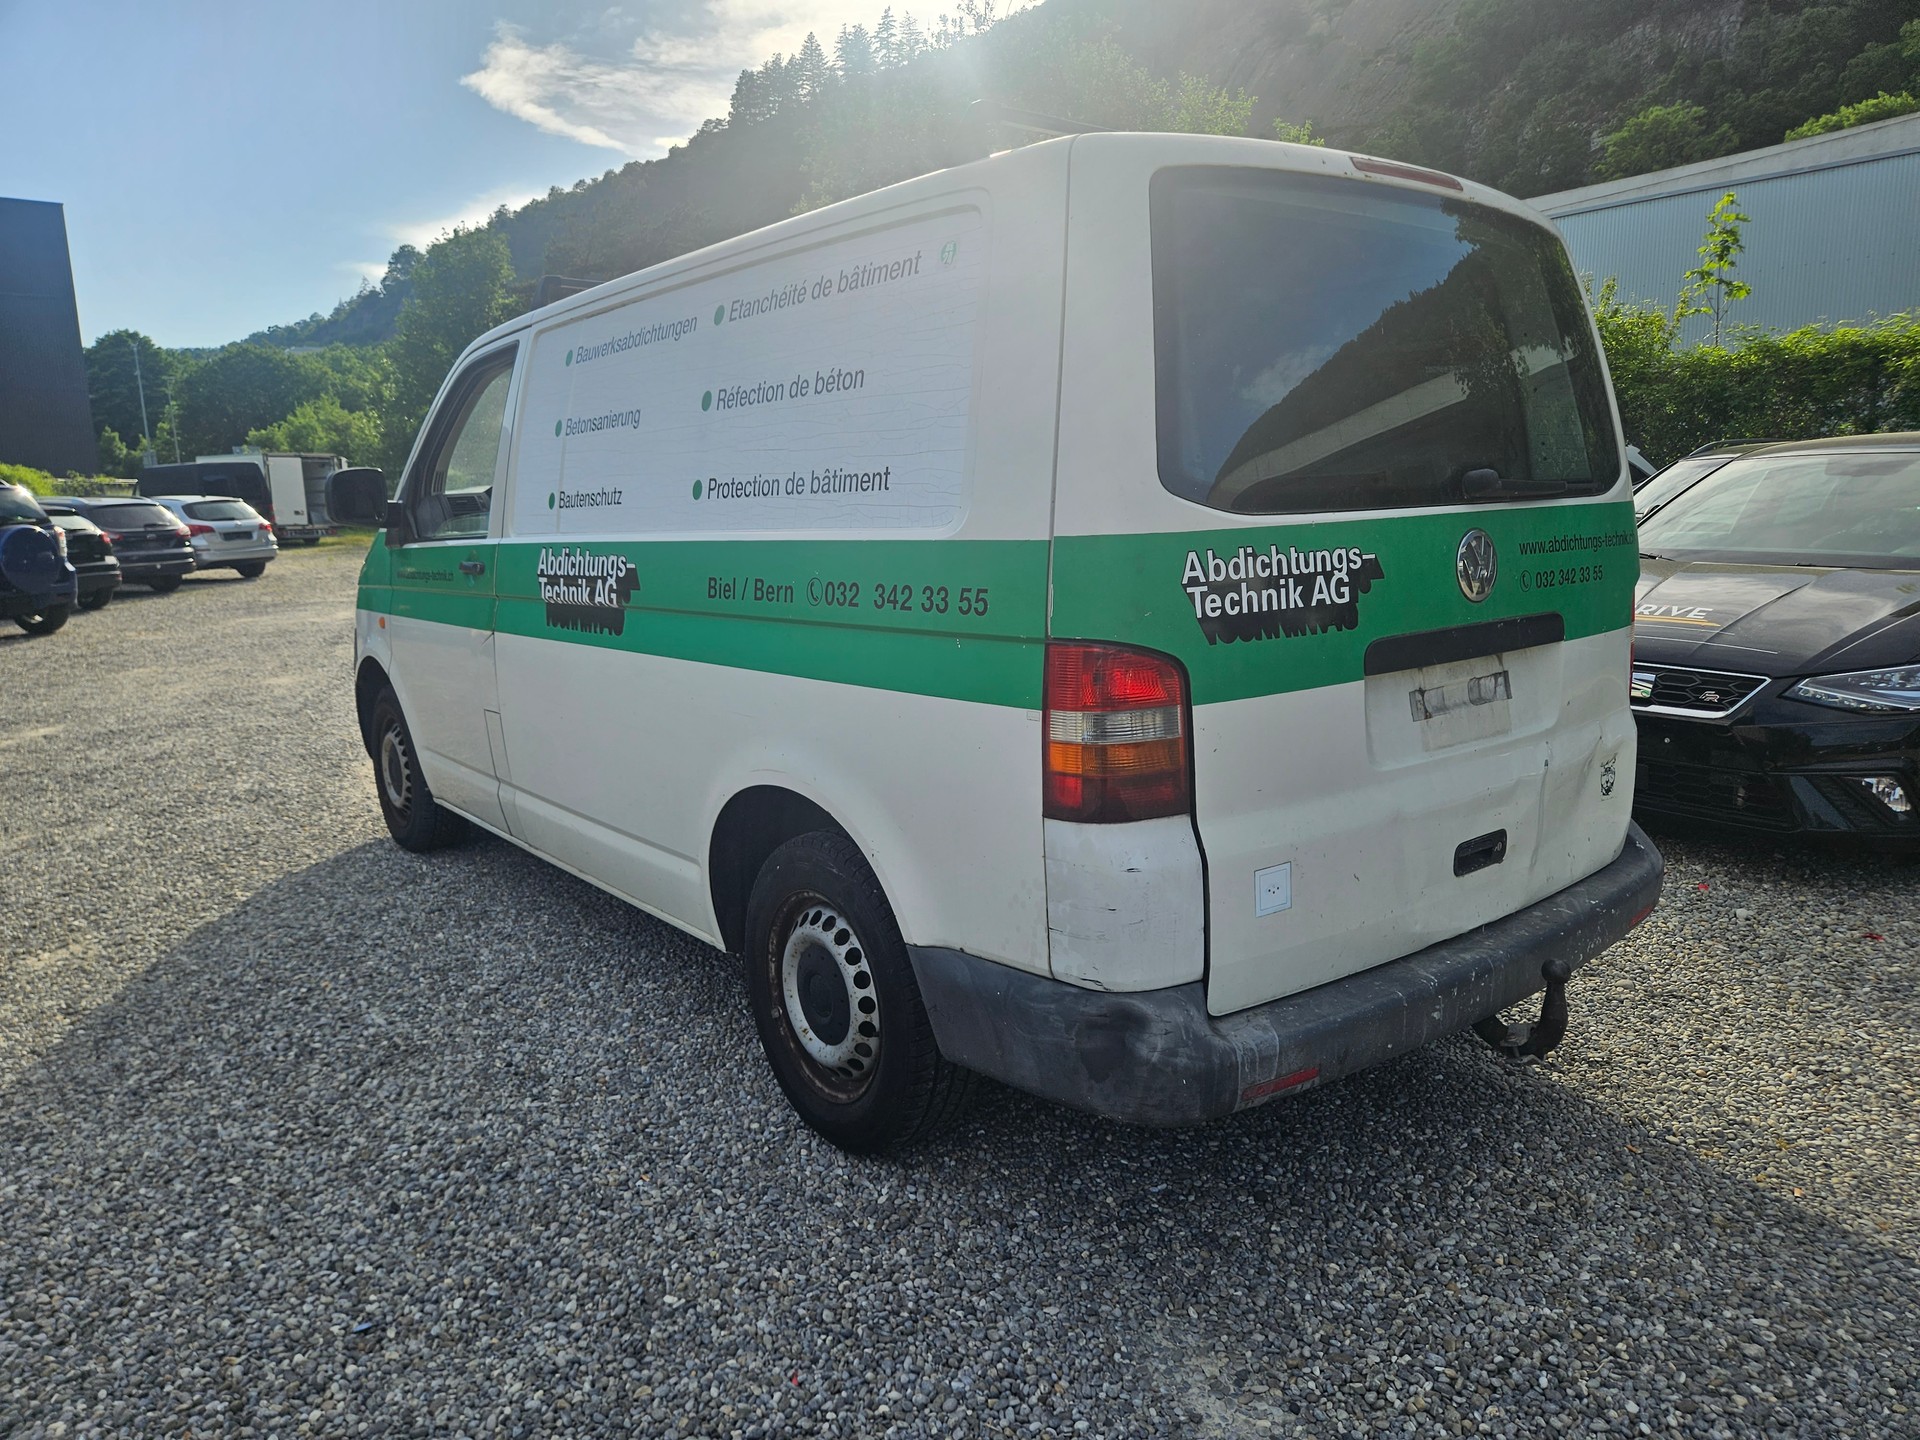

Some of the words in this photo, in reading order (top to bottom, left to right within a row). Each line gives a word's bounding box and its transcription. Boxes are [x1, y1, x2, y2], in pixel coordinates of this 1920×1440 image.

[728, 279, 807, 322] Etanchéité
[811, 275, 832, 297] de
[837, 250, 921, 294] bâtiment
[575, 315, 697, 364] Bauwerksabdichtungen
[717, 378, 784, 411] Réfection
[789, 374, 810, 397] de
[814, 367, 865, 395] béton
[565, 407, 641, 437] Betonsanierung
[558, 487, 622, 510] Bautenschutz
[707, 474, 779, 500] Protection
[784, 472, 805, 494] de
[810, 466, 890, 494] bâtiment
[537, 548, 636, 578] Abdichtungs-
[1182, 545, 1376, 585] Abdichtungs-
[1535, 571, 1555, 589] 032
[1558, 568, 1576, 586] 342
[1579, 566, 1591, 583] 33
[1593, 564, 1603, 581] 55
[539, 577, 590, 607] Technik
[591, 580, 617, 608] AG
[707, 577, 737, 601] Biel
[741, 578, 749, 602] /
[754, 577, 794, 603] Bern
[824, 581, 860, 608] 032
[873, 584, 912, 612] 342
[921, 586, 949, 614] 33
[958, 588, 989, 616] 55
[1187, 574, 1303, 618] Technik
[1310, 574, 1350, 605] AG
[1636, 604, 1714, 619] RIVE
